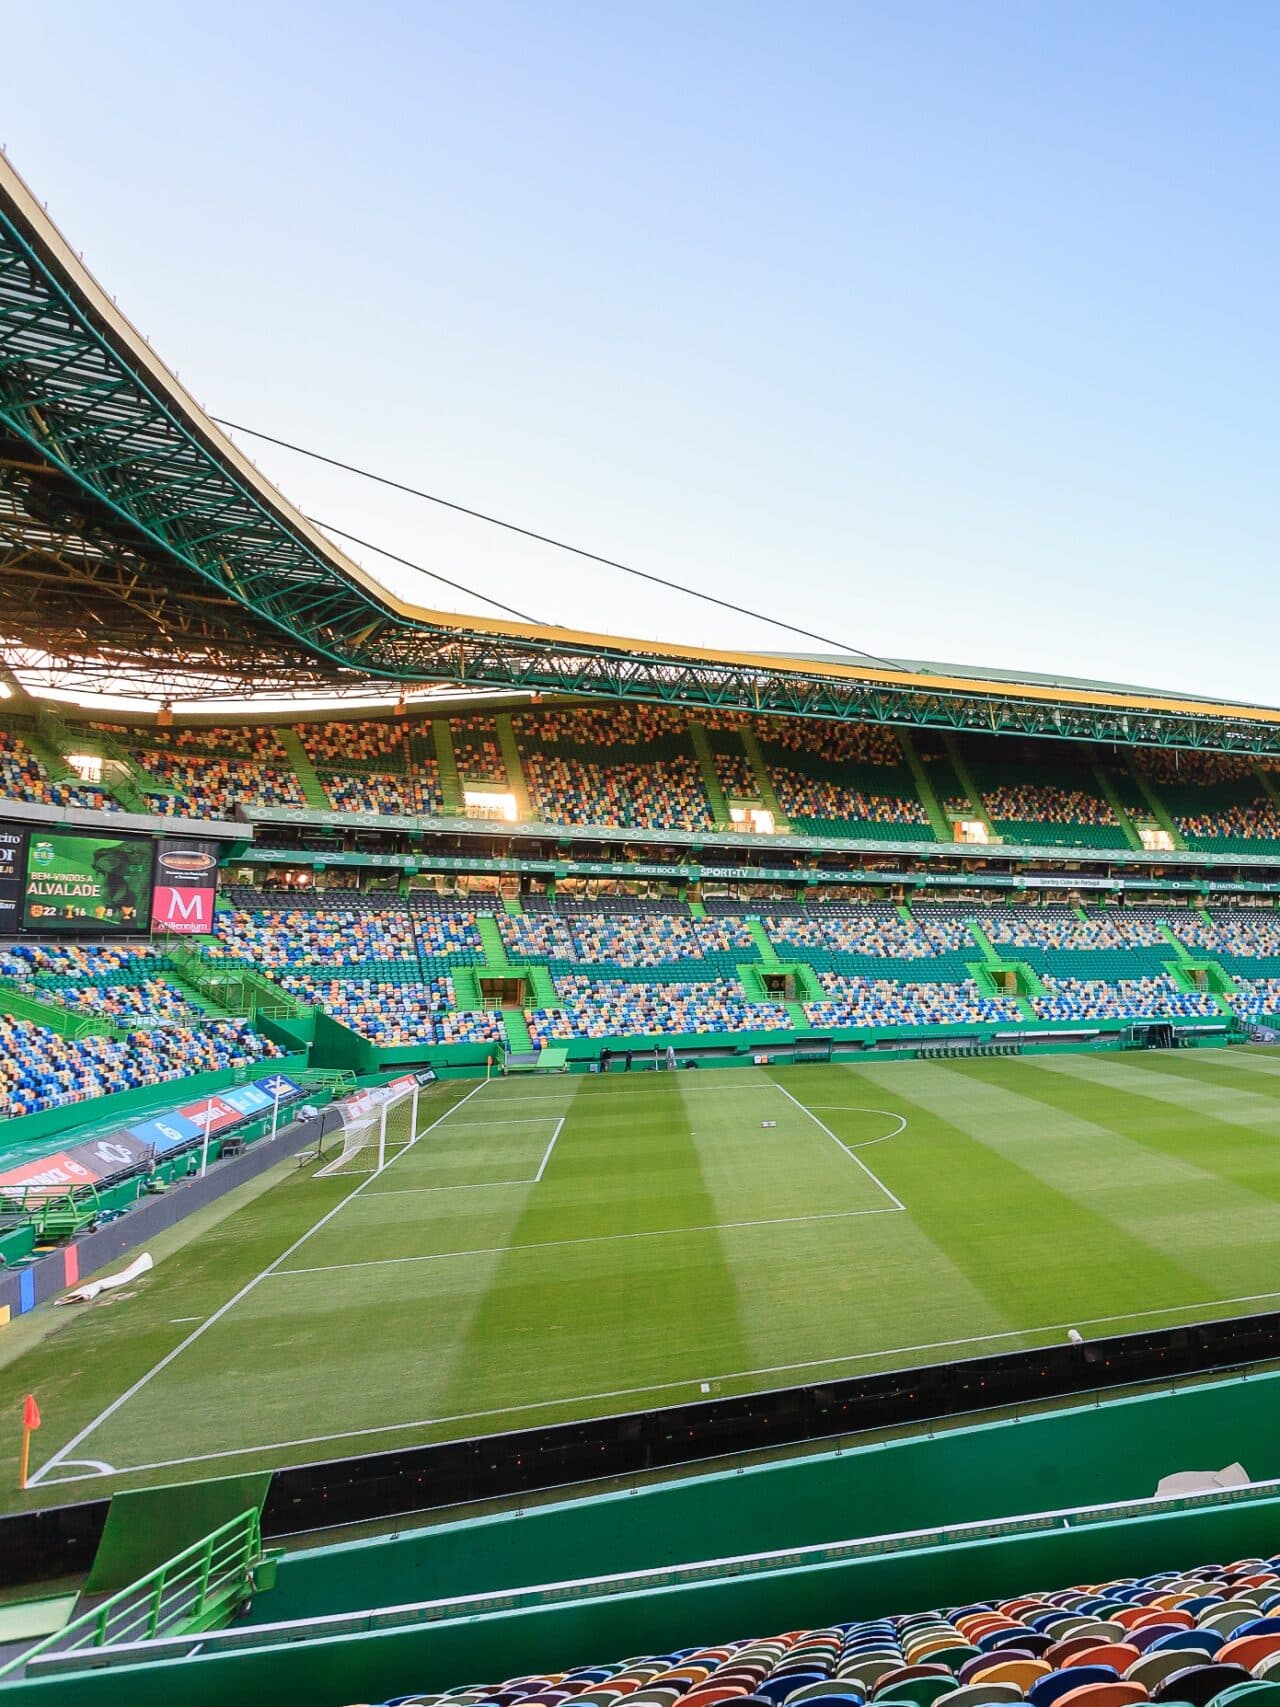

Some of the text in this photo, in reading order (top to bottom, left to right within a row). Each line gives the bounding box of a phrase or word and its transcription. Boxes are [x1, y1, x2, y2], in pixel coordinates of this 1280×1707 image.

[27, 882, 101, 897] ALVALADE
[167, 888, 203, 920] M
[43, 907, 57, 916] 22
[75, 908, 86, 916] 16
